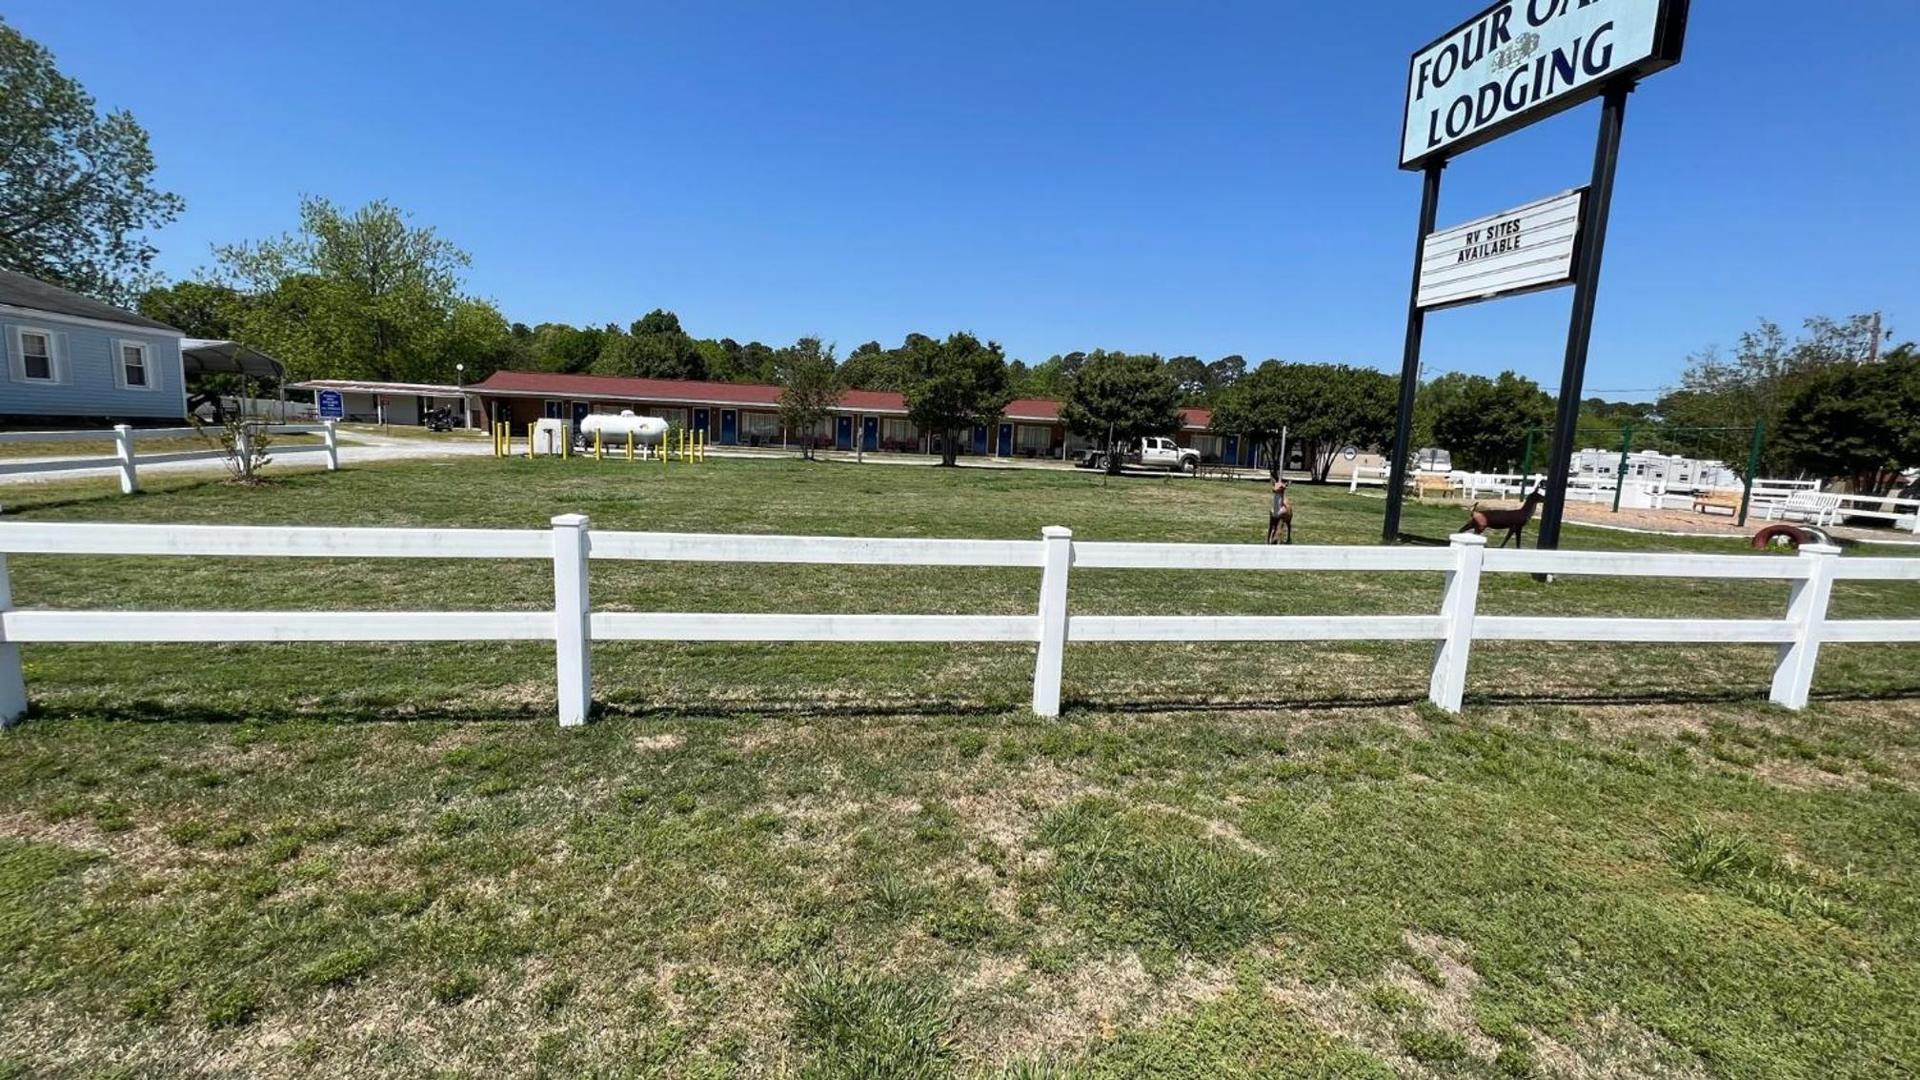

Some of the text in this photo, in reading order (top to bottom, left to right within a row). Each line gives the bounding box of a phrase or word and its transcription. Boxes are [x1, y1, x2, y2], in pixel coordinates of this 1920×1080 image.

[1416, 5, 1512, 101] FOUR
[1427, 21, 1614, 148] LODGING
[1457, 236, 1521, 263] AVAILABLE
[1466, 219, 1521, 245] RV SITES
